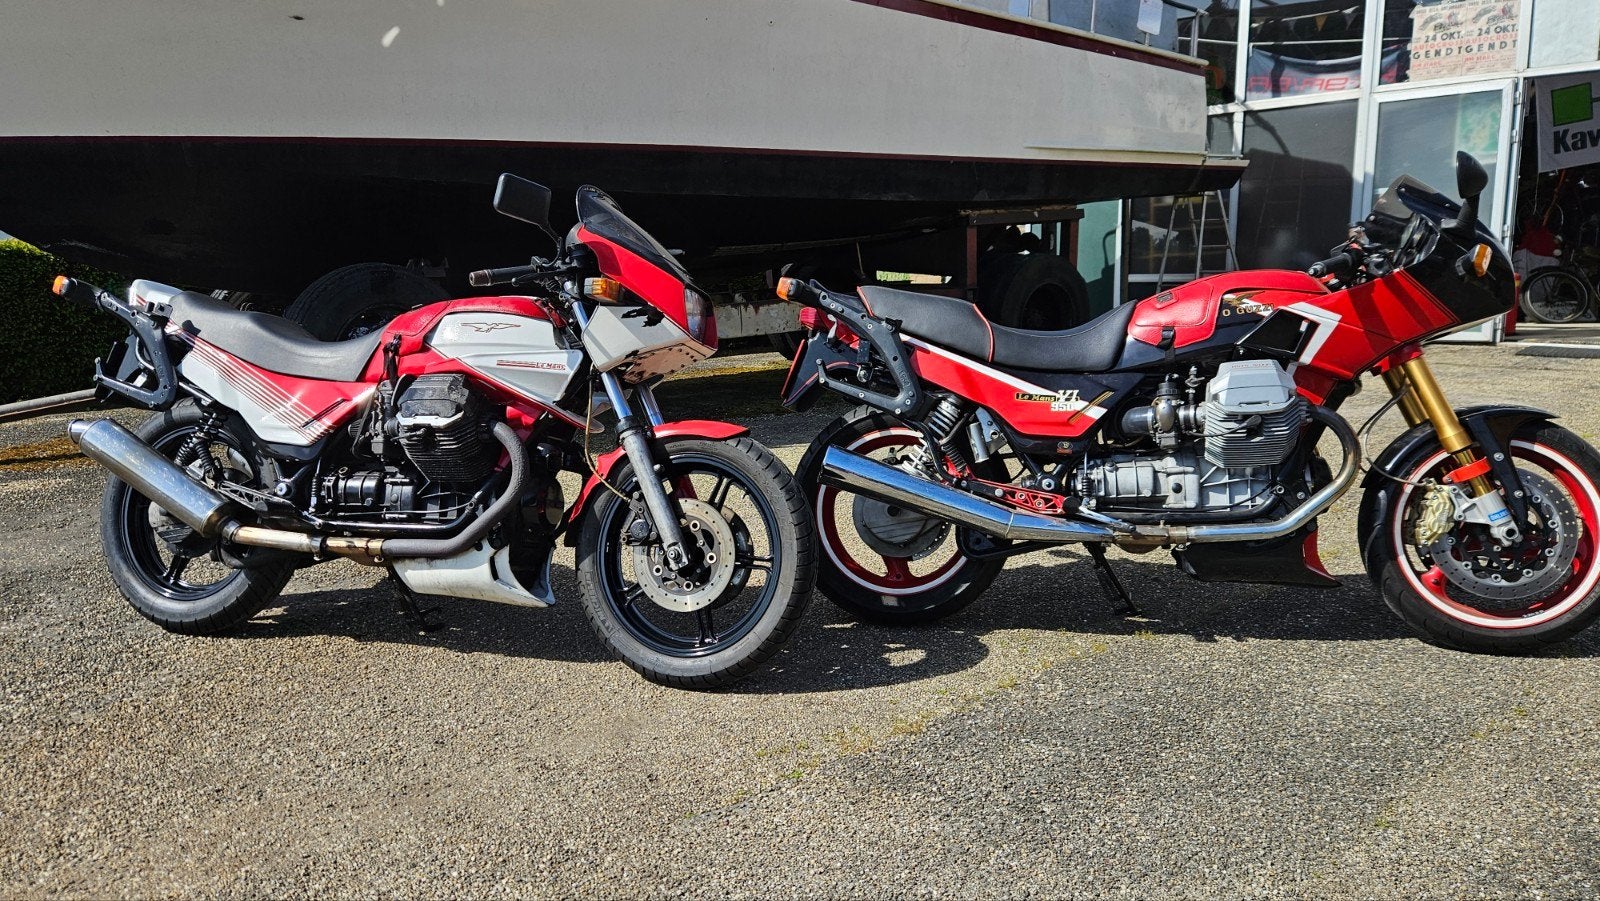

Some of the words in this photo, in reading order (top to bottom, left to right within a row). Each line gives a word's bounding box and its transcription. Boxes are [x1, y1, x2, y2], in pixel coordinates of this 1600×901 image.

[1477, 27, 1491, 37] 24
[1424, 35, 1437, 43] 24
[1464, 40, 1518, 54] GENDT
[1413, 46, 1463, 60] GENDT
[1236, 303, 1275, 315] GUZZI
[1018, 393, 1030, 401] Le
[1031, 393, 1056, 402] Mans
